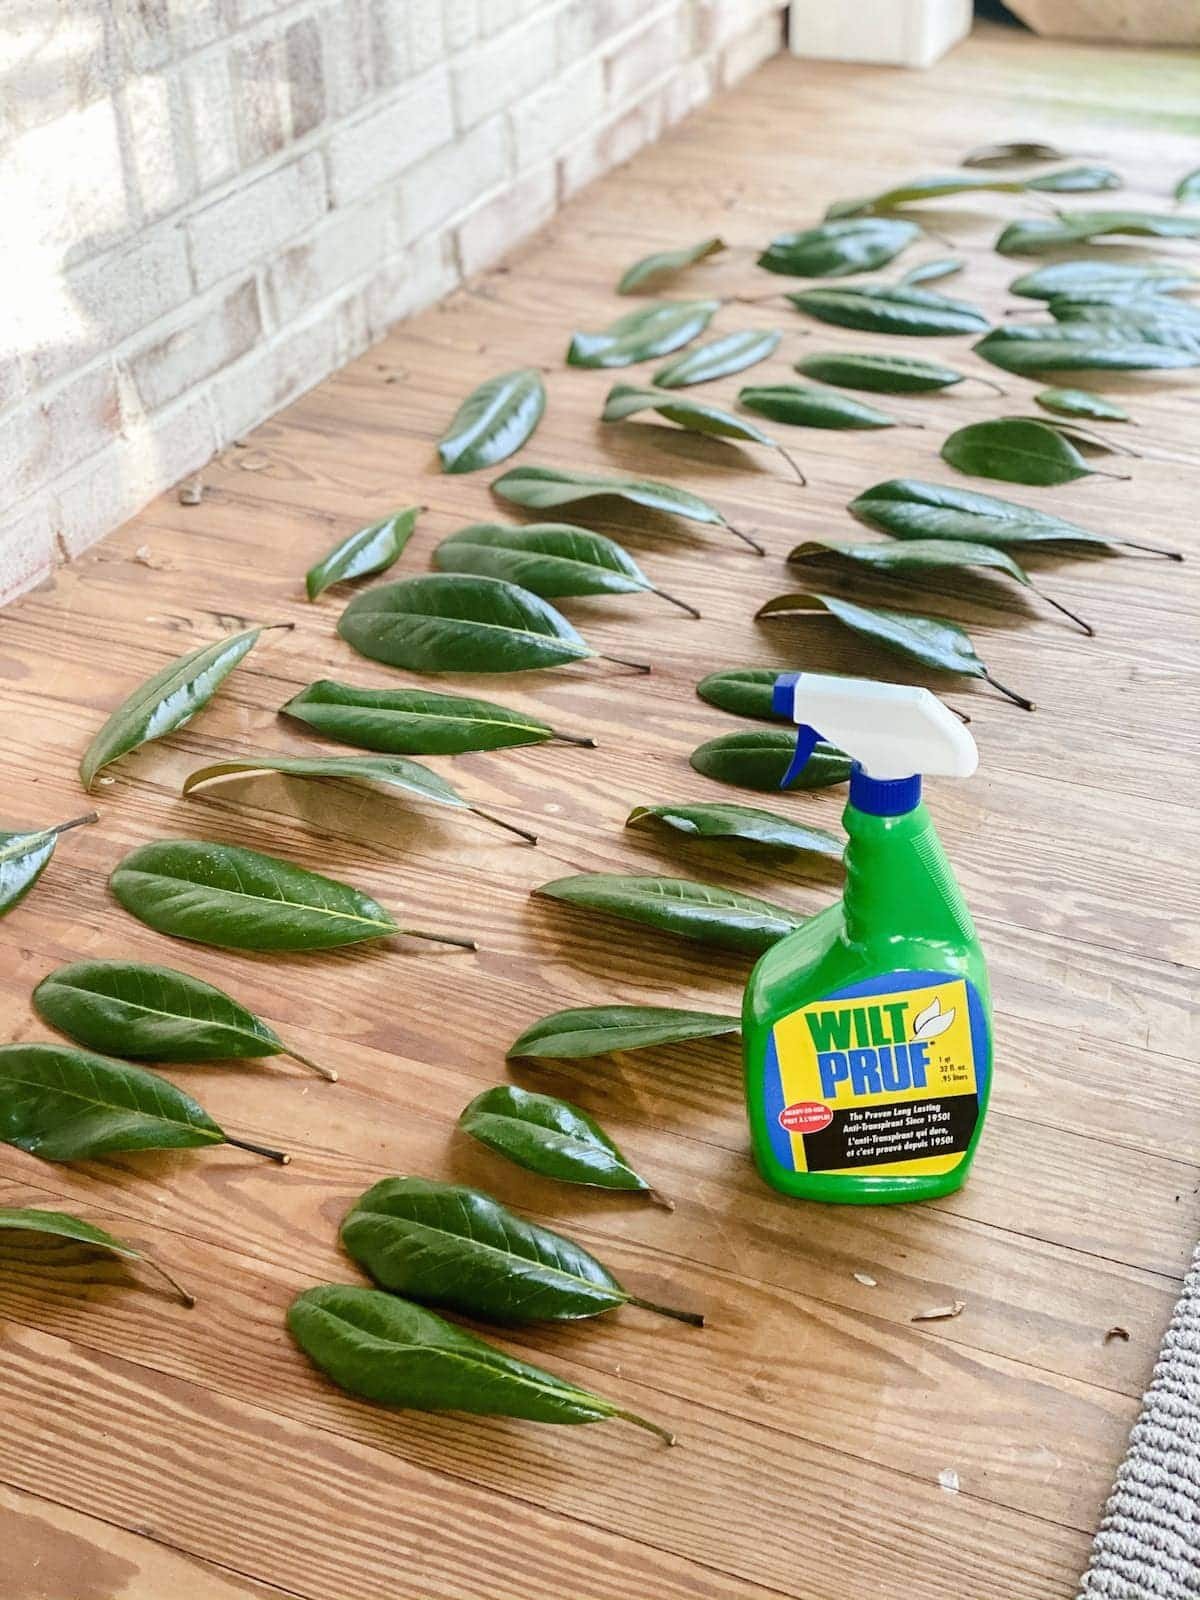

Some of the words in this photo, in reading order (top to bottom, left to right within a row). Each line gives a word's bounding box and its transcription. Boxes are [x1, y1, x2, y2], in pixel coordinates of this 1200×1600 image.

[805, 1002, 908, 1051] WILT
[817, 1042, 930, 1098] PRUF
[843, 1119, 903, 1133] Anti-Transpirant
[904, 1116, 925, 1126] Since
[927, 1111, 951, 1123] 1950!
[849, 1111, 863, 1121] The
[864, 1110, 892, 1120] Proven
[893, 1107, 912, 1117] Long
[913, 1103, 941, 1113] Lasting
[903, 1139, 929, 1151] depuis
[930, 1135, 954, 1147] 1950!
